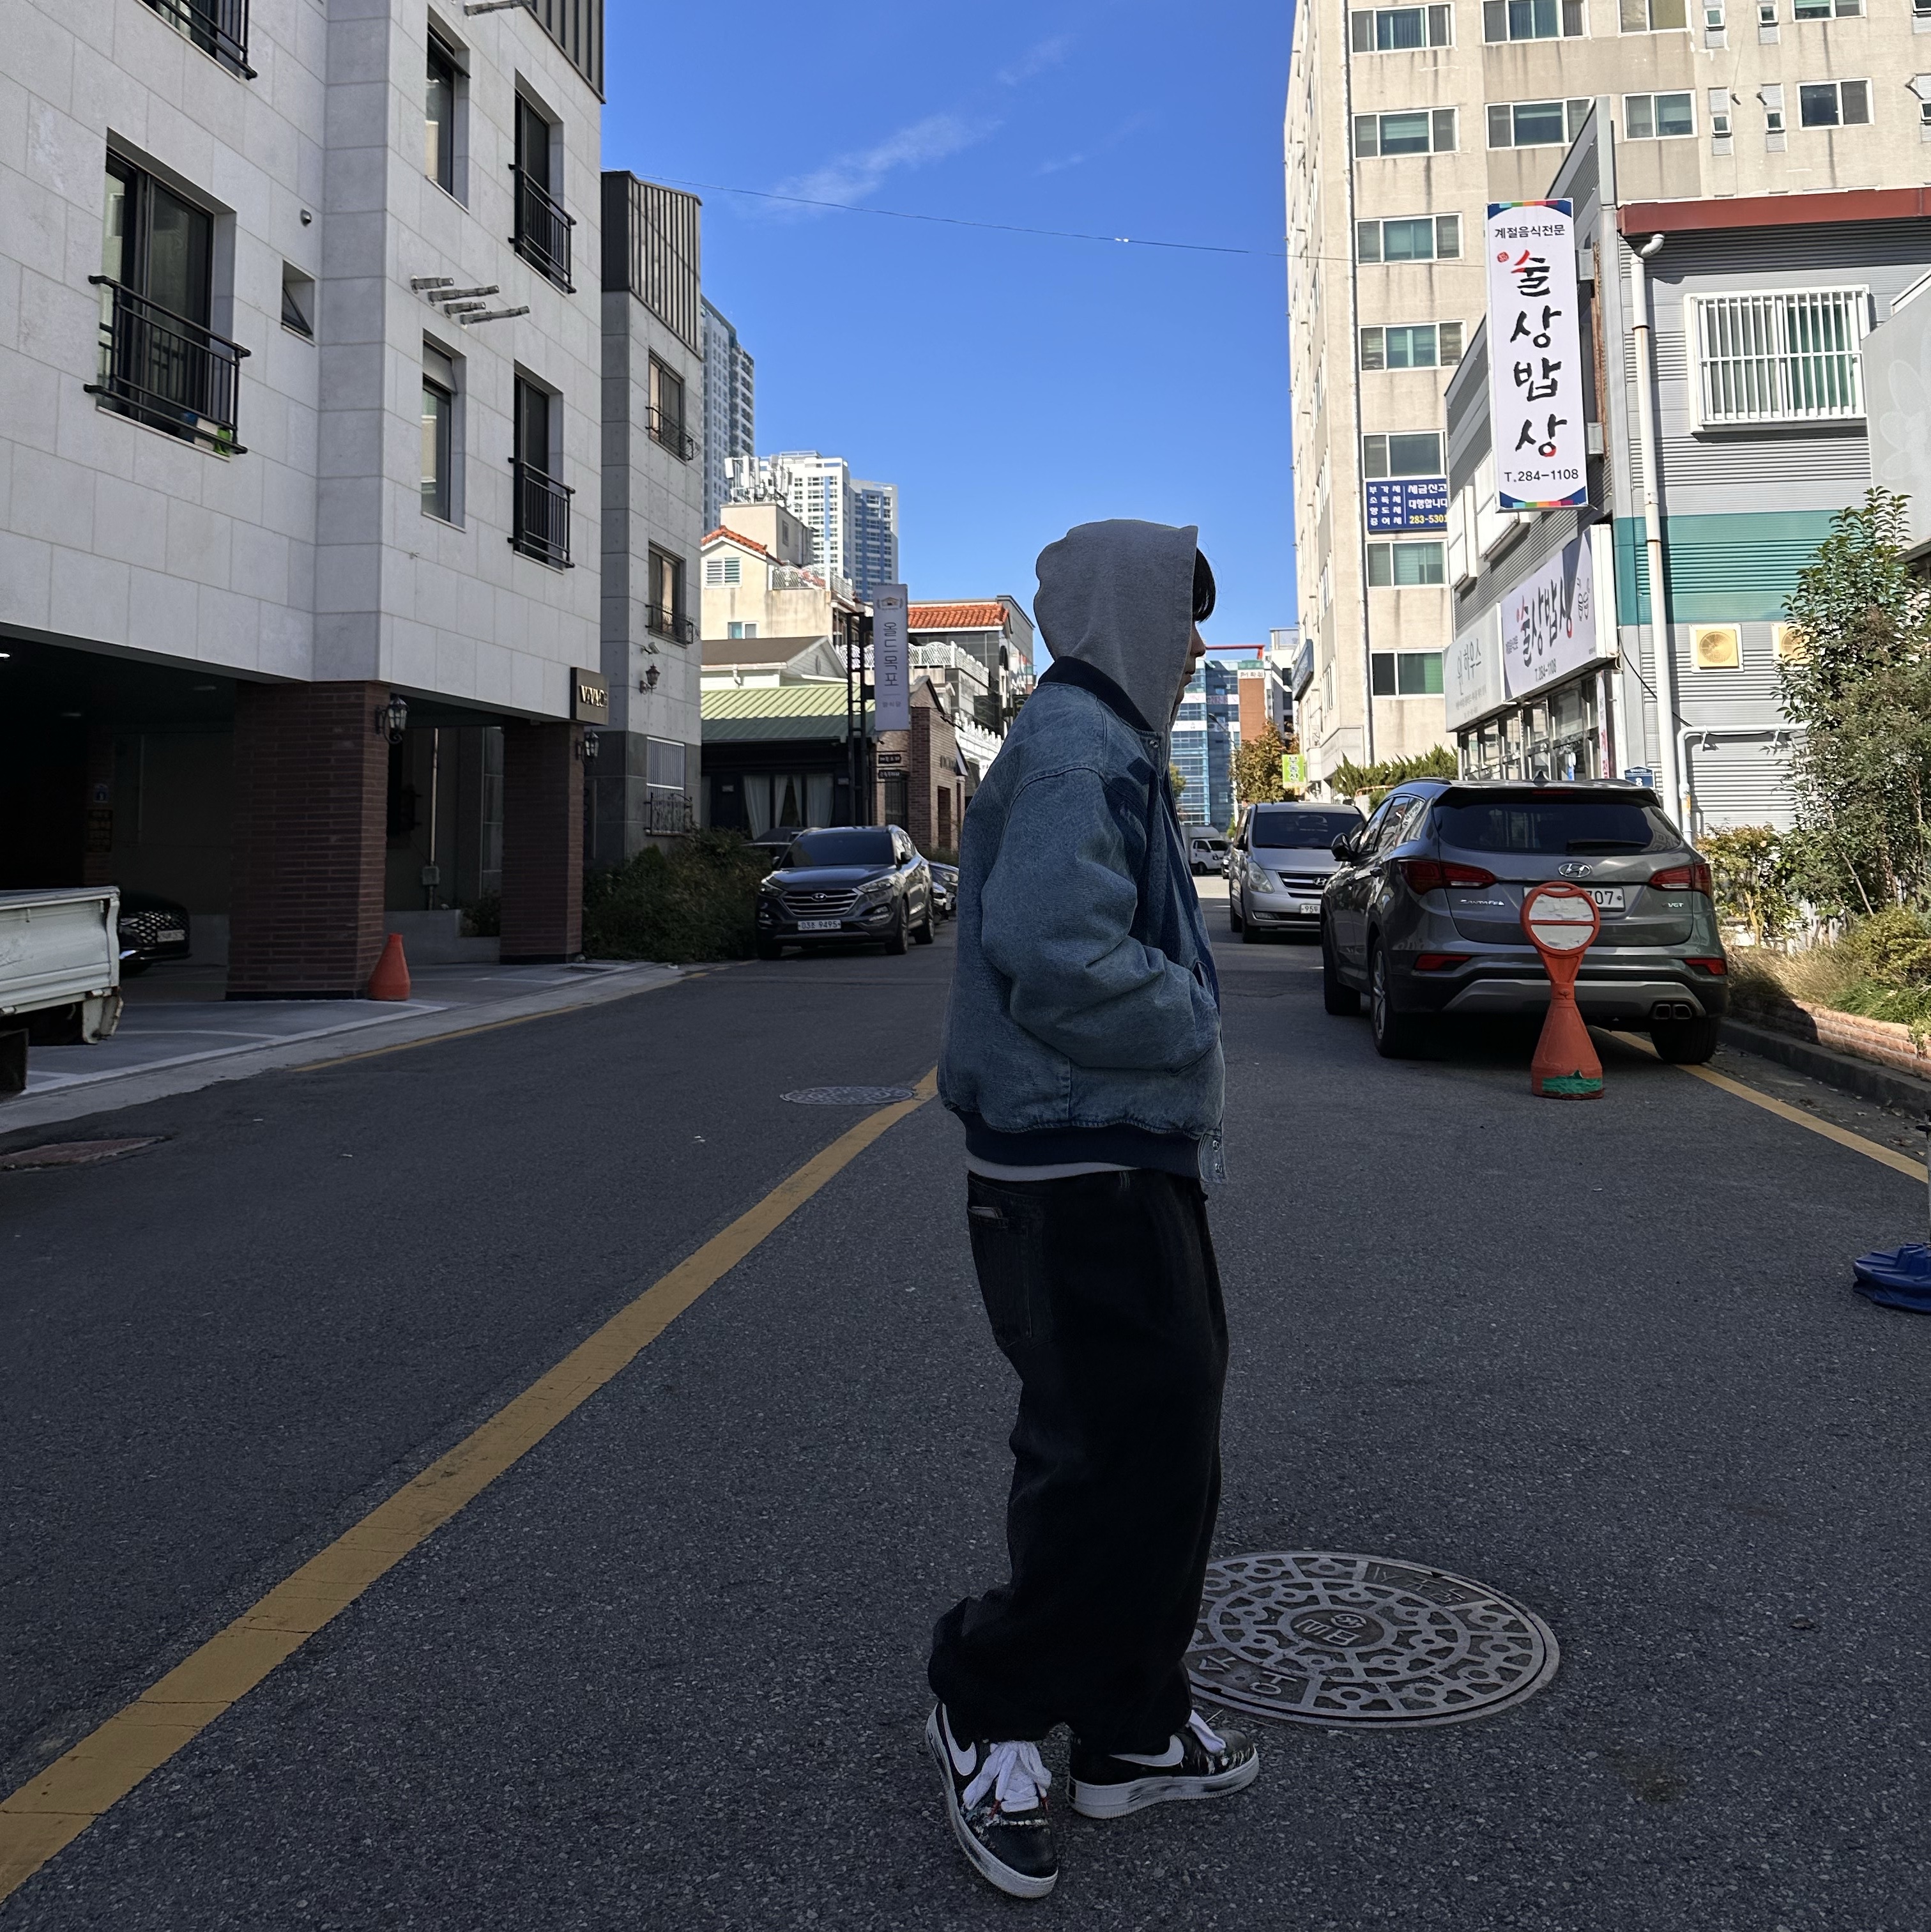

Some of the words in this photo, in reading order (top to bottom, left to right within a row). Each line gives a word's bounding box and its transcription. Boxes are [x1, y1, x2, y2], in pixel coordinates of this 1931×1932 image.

[1495, 224, 1565, 239] 계절음식전문
[1510, 249, 1568, 457] 술상밥상
[1504, 469, 1579, 483] T.284-1108
[1408, 484, 1447, 494] 세금신고
[1520, 576, 1573, 668] 술상밥상
[883, 622, 899, 687] 올드목포
[1288, 756, 1299, 782] 부동산
[1635, 777, 1643, 786] 8
